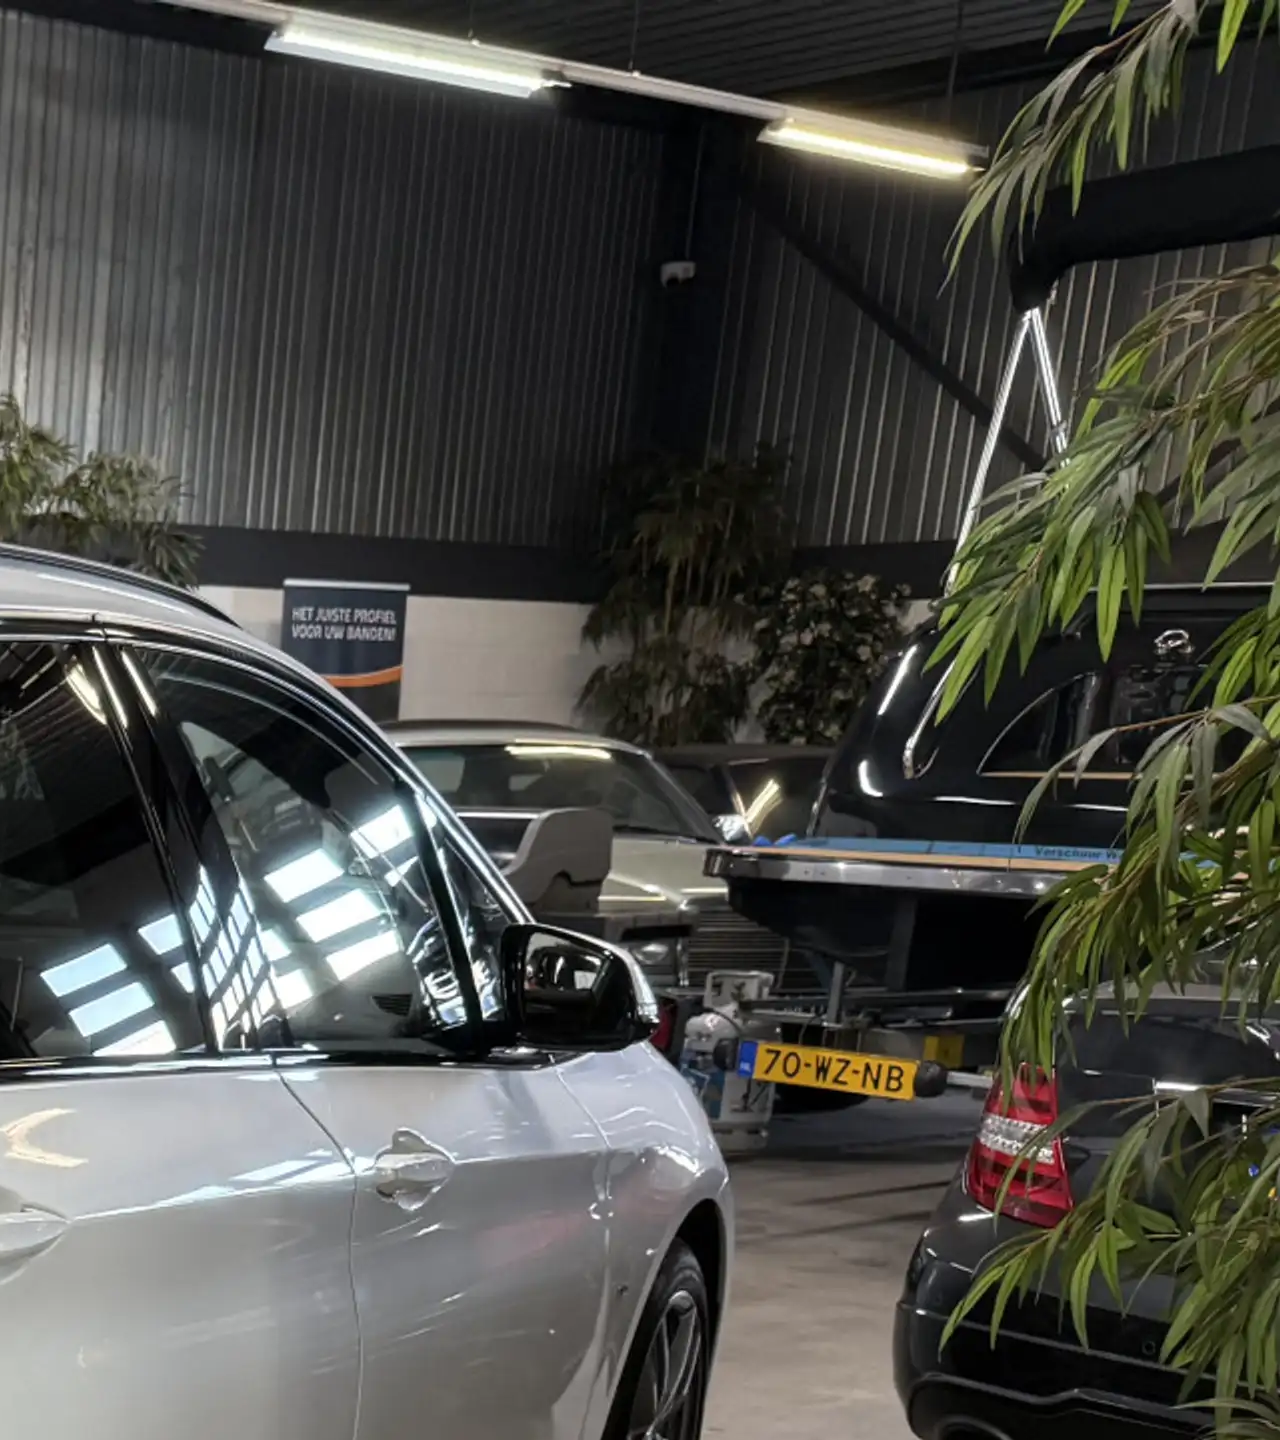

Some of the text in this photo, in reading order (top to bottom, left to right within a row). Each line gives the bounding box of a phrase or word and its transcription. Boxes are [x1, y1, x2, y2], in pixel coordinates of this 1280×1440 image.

[291, 606, 397, 625] HET JUISTE PROFIEL
[291, 624, 397, 642] VOOR UW BANDEN!
[764, 1049, 904, 1093] 70-WZ-NB
